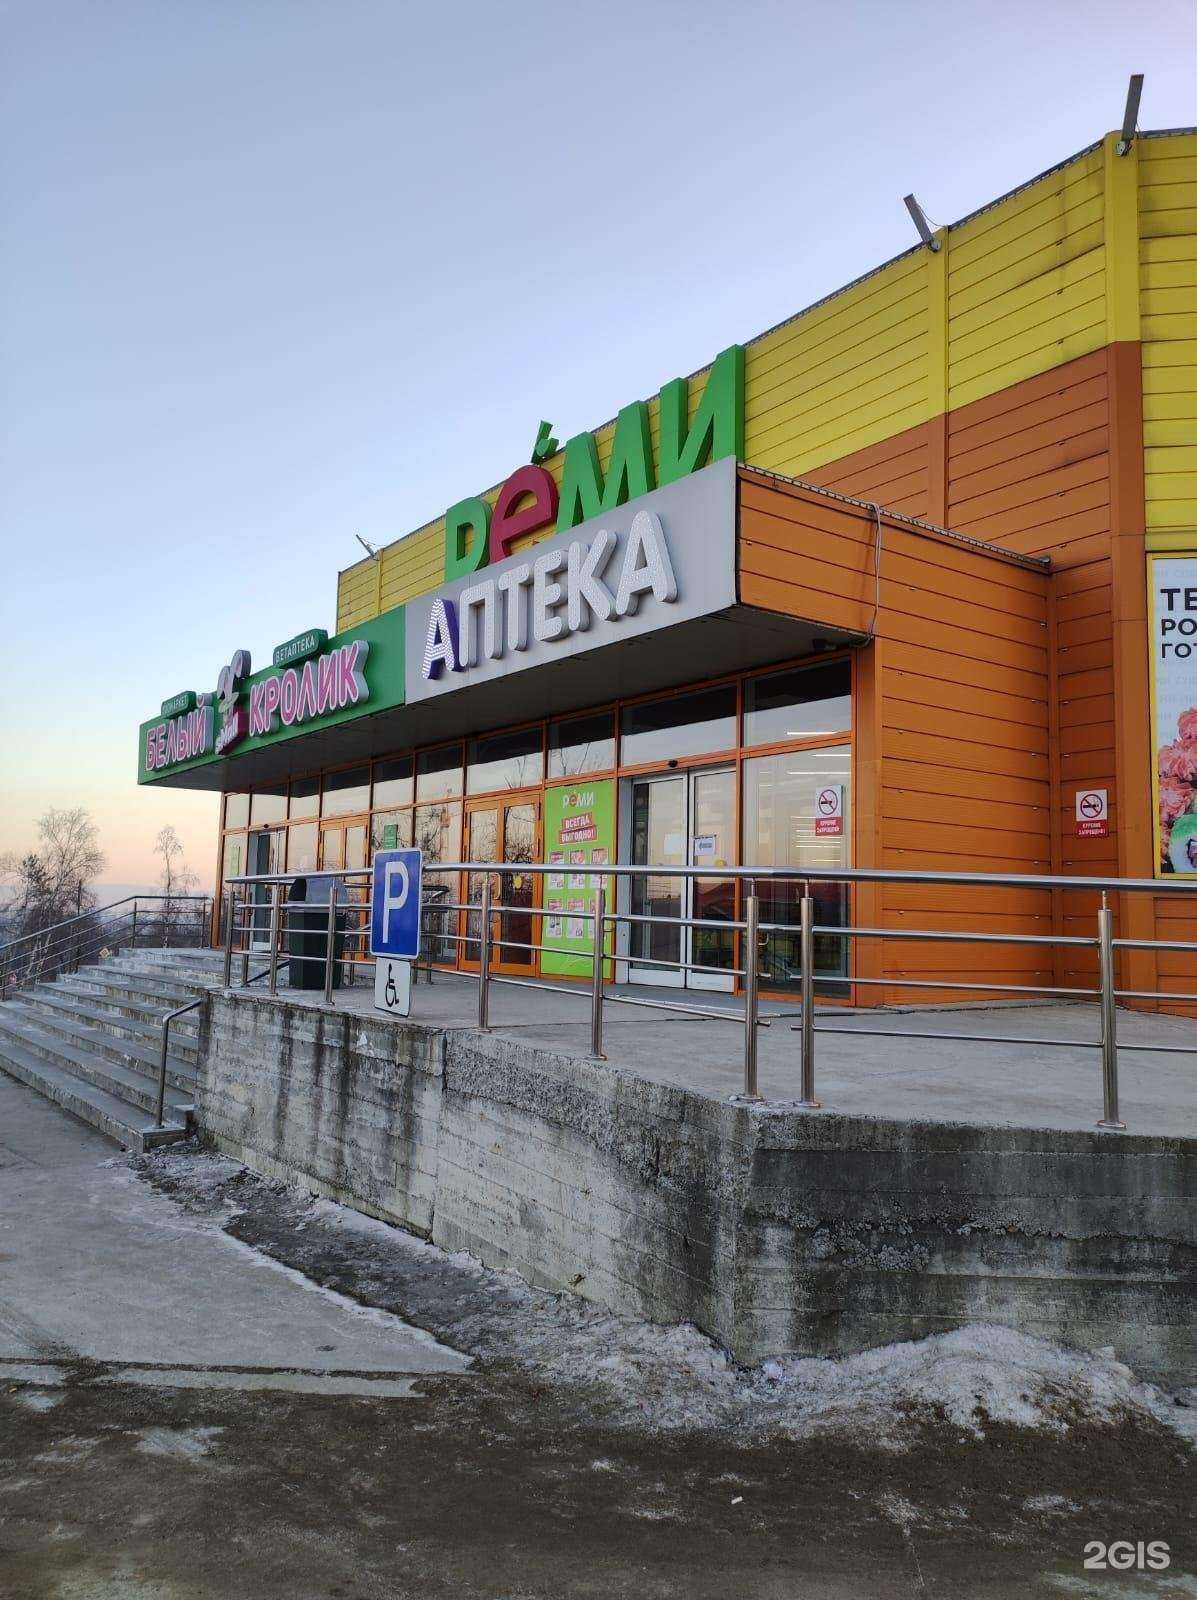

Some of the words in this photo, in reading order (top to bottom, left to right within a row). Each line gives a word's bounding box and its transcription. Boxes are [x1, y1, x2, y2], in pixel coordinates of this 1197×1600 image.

[421, 510, 679, 680] АПТЕКА
[1160, 587, 1197, 611] ТЕ
[1161, 617, 1197, 636] РО
[146, 692, 211, 771] БЕЛЫЙ
[249, 639, 369, 737] КРОЛИК
[382, 861, 410, 944] P
